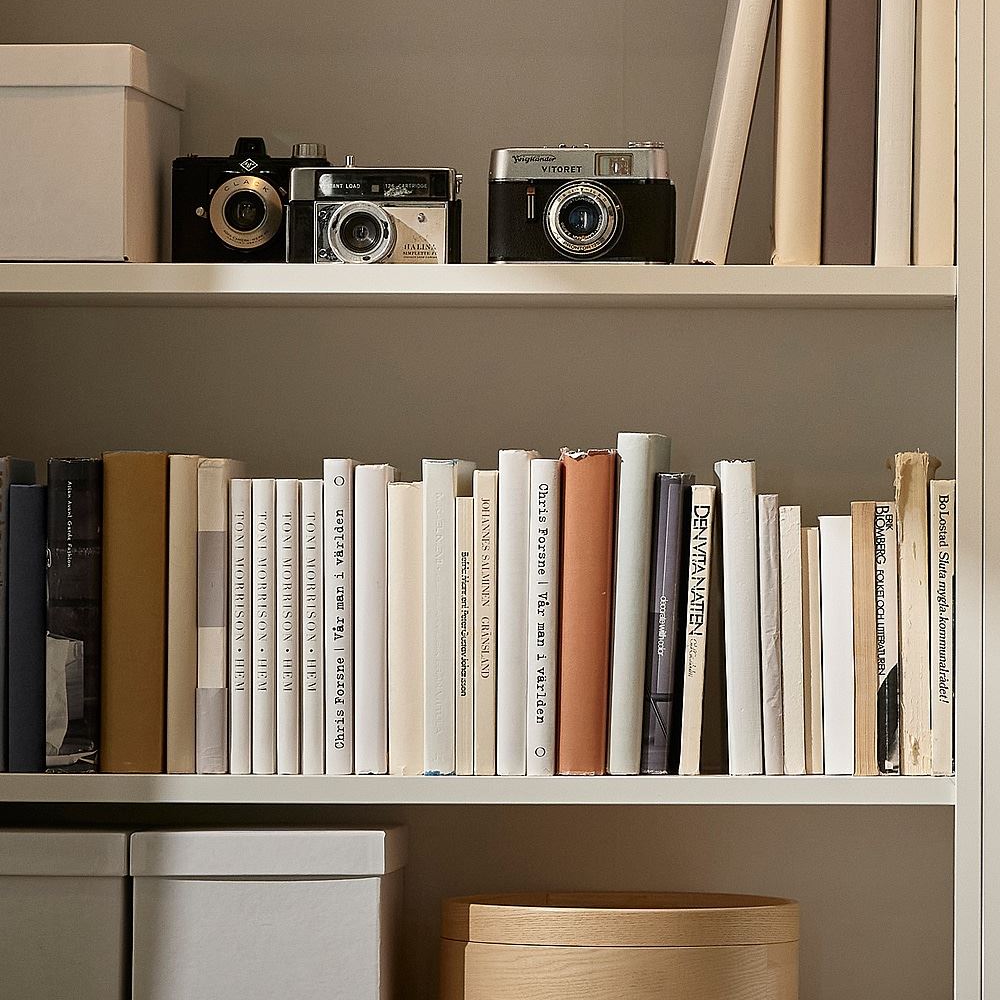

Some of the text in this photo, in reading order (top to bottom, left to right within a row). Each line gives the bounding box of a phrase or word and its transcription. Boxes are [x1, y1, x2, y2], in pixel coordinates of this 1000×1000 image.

[224, 179, 269, 193] CLACK
[537, 483, 548, 523] Chris
[939, 495, 949, 510] Bo
[334, 509, 345, 566] världen
[693, 505, 710, 540] DEN
[875, 506, 890, 564] BLOMBERG
[885, 514, 893, 530] ERIK
[939, 511, 950, 547] Lostad
[537, 528, 548, 576] Forsne
[692, 542, 707, 575] VITA
[938, 552, 949, 579] Sluta
[235, 511, 246, 692] TONI MORRISON HEM
[257, 511, 268, 692] TONI MORRISON HEM
[282, 511, 293, 692] TONI MORRISON HEM
[306, 511, 317, 692] TONI MORRISON HEM
[336, 587, 345, 611] man
[480, 498, 492, 679] JOHANNES SALMINEN GRÄNSLAND
[876, 570, 885, 598] FOLKET
[537, 591, 551, 617] Vår
[659, 595, 669, 625] decorate
[689, 577, 706, 636] NATTEN
[876, 600, 885, 620] OCH
[332, 615, 345, 641] Vår
[536, 622, 545, 647] man
[658, 625, 668, 640] with
[938, 616, 950, 704] kommunalrådet!
[334, 657, 345, 705] Forsne
[535, 667, 548, 724] världen
[334, 709, 345, 750] Chris
